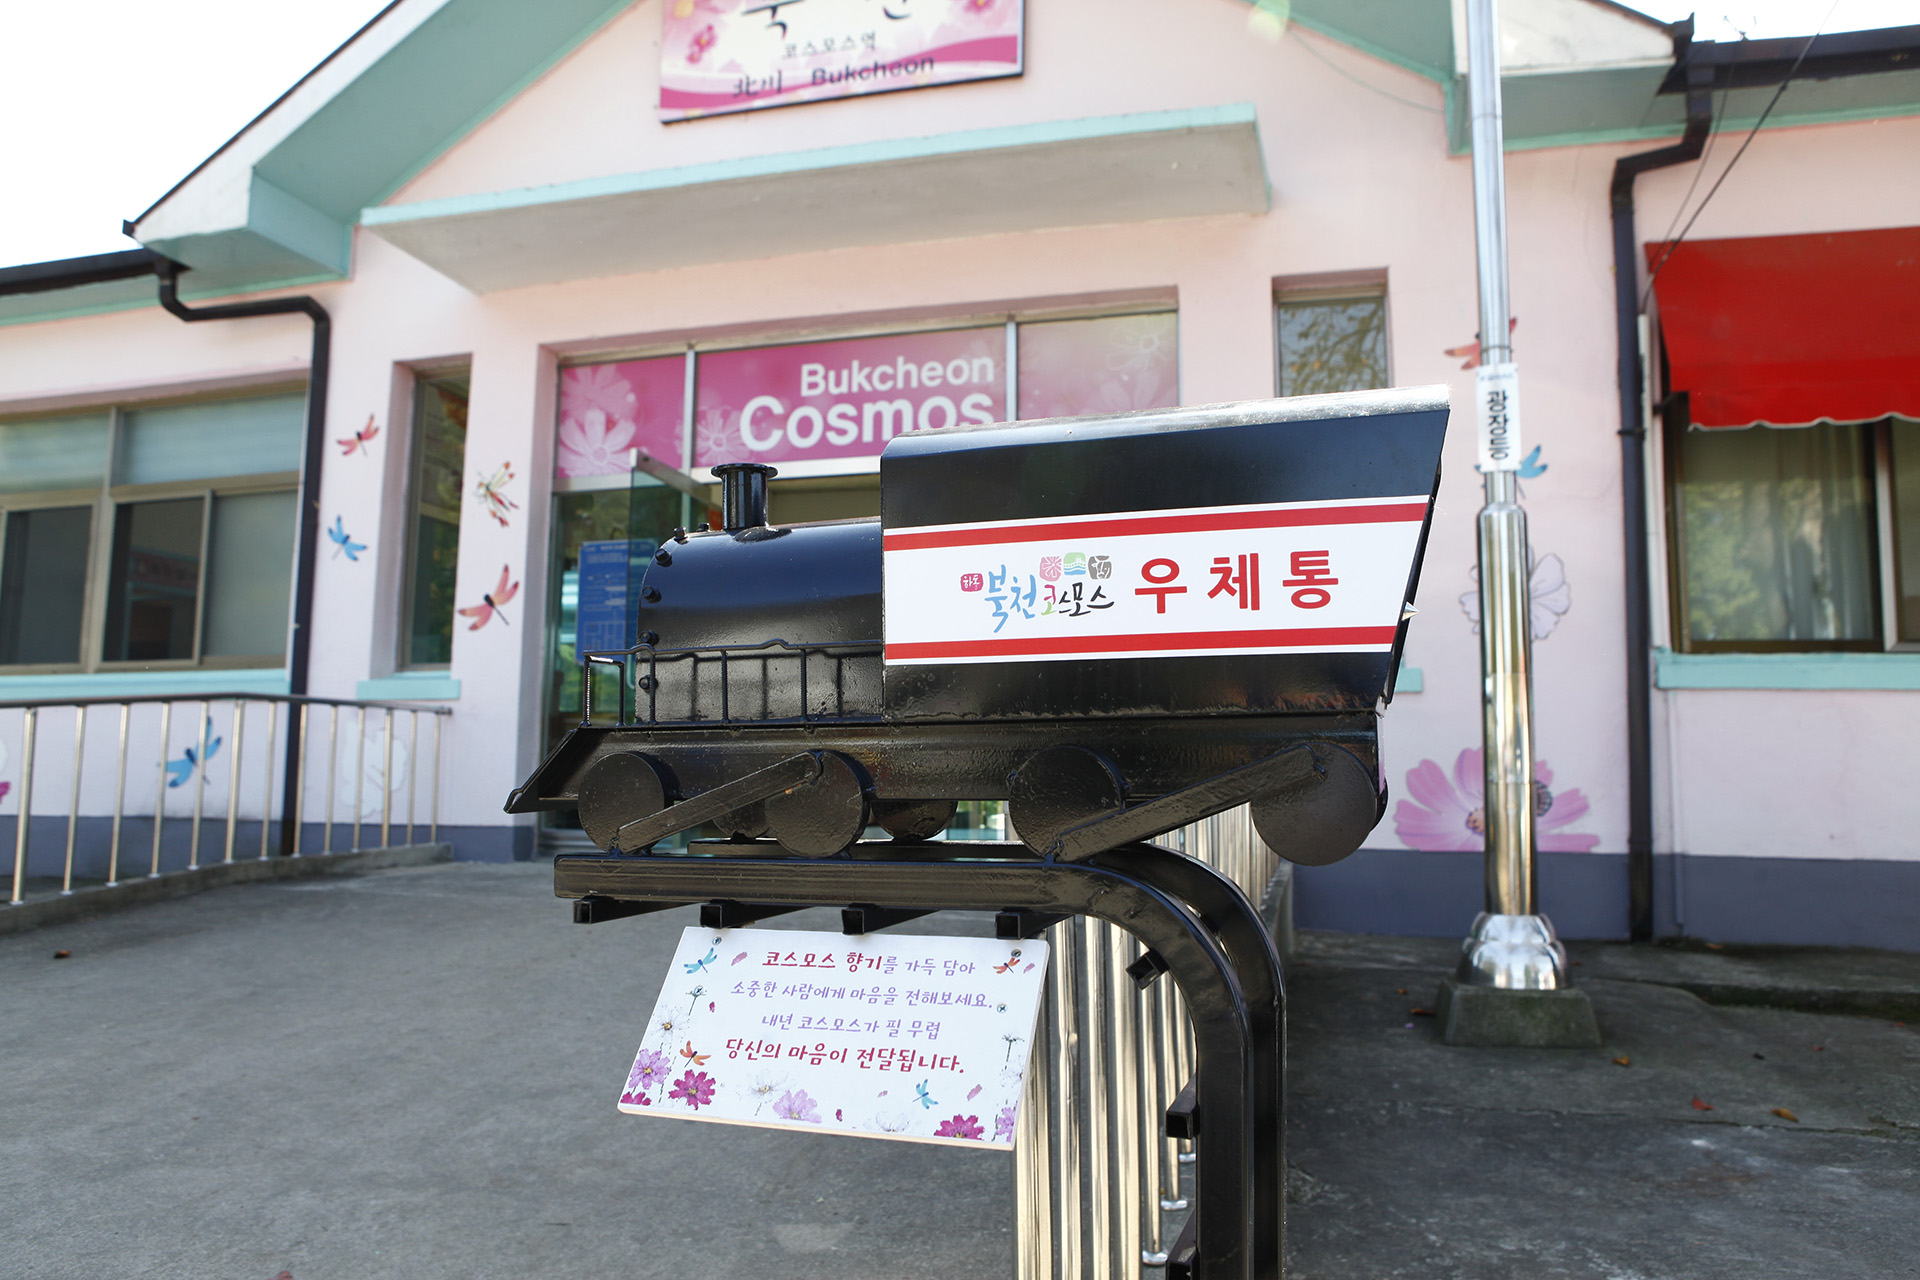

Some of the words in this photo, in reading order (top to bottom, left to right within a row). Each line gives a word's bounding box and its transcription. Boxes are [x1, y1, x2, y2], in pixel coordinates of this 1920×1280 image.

[812, 56, 934, 85] Bukcheon
[800, 356, 994, 397] Bukcheon
[739, 393, 995, 452] Cosmos
[1134, 550, 1338, 614] 우체통
[762, 951, 836, 968] 코스모스
[846, 951, 898, 975] 향기를
[904, 958, 936, 976] 가득
[943, 960, 976, 976] 담아
[730, 980, 778, 999] 소중한
[782, 983, 846, 1000] 사람에게
[849, 986, 899, 1006] 마음을
[905, 989, 993, 1009] 전해보세요.
[762, 1013, 793, 1031] 내년
[797, 1016, 880, 1033] 코스모스가
[886, 1019, 901, 1038] 필
[907, 1020, 941, 1040] 무렵
[726, 1038, 782, 1060] 당신의
[788, 1043, 848, 1066] 마음이
[856, 1047, 965, 1074] 전달됩니다.
